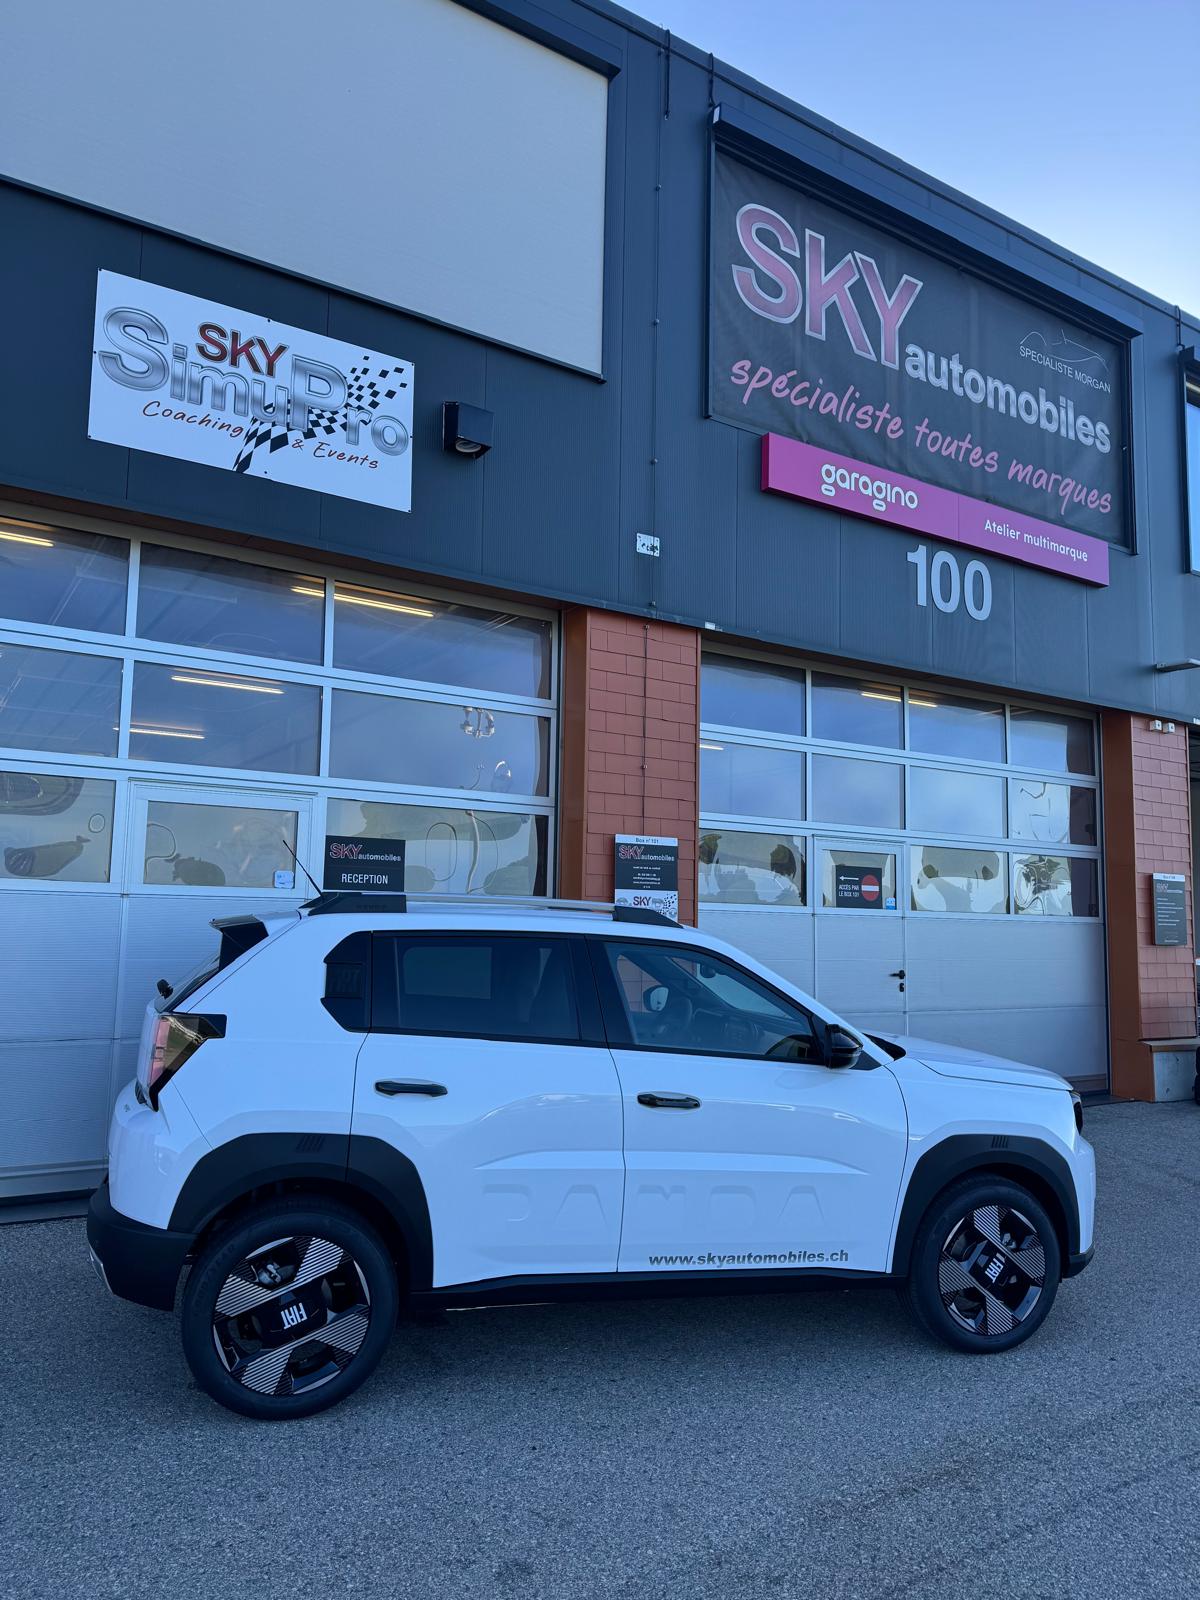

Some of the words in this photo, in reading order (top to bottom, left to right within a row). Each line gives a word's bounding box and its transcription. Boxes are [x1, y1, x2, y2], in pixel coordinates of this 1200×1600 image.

[196, 321, 290, 378] SKY
[732, 203, 923, 370] SKY
[905, 343, 1111, 454] automobiles
[98, 306, 409, 456] SimuPro
[1019, 345, 1073, 379] SPECIALISTE
[1074, 369, 1111, 393] MORGAN
[142, 400, 244, 438] Coaching
[292, 438, 305, 452] &
[313, 441, 379, 470] Events
[730, 358, 904, 440] spécialiste
[915, 418, 999, 473] toutes
[1008, 459, 1112, 515] marques
[821, 463, 918, 512] garagino
[984, 519, 1021, 541] Atelier
[1023, 532, 1088, 562] multimarque
[906, 545, 993, 621] 100
[329, 842, 362, 860] SKY
[358, 853, 402, 862] automobiles
[619, 845, 644, 859] SKY
[341, 873, 389, 885] RECEPTION
[633, 896, 652, 906] SKY
[648, 1249, 850, 1268] www.skyautomobiles.ch
[280, 1302, 309, 1330] FIAT
